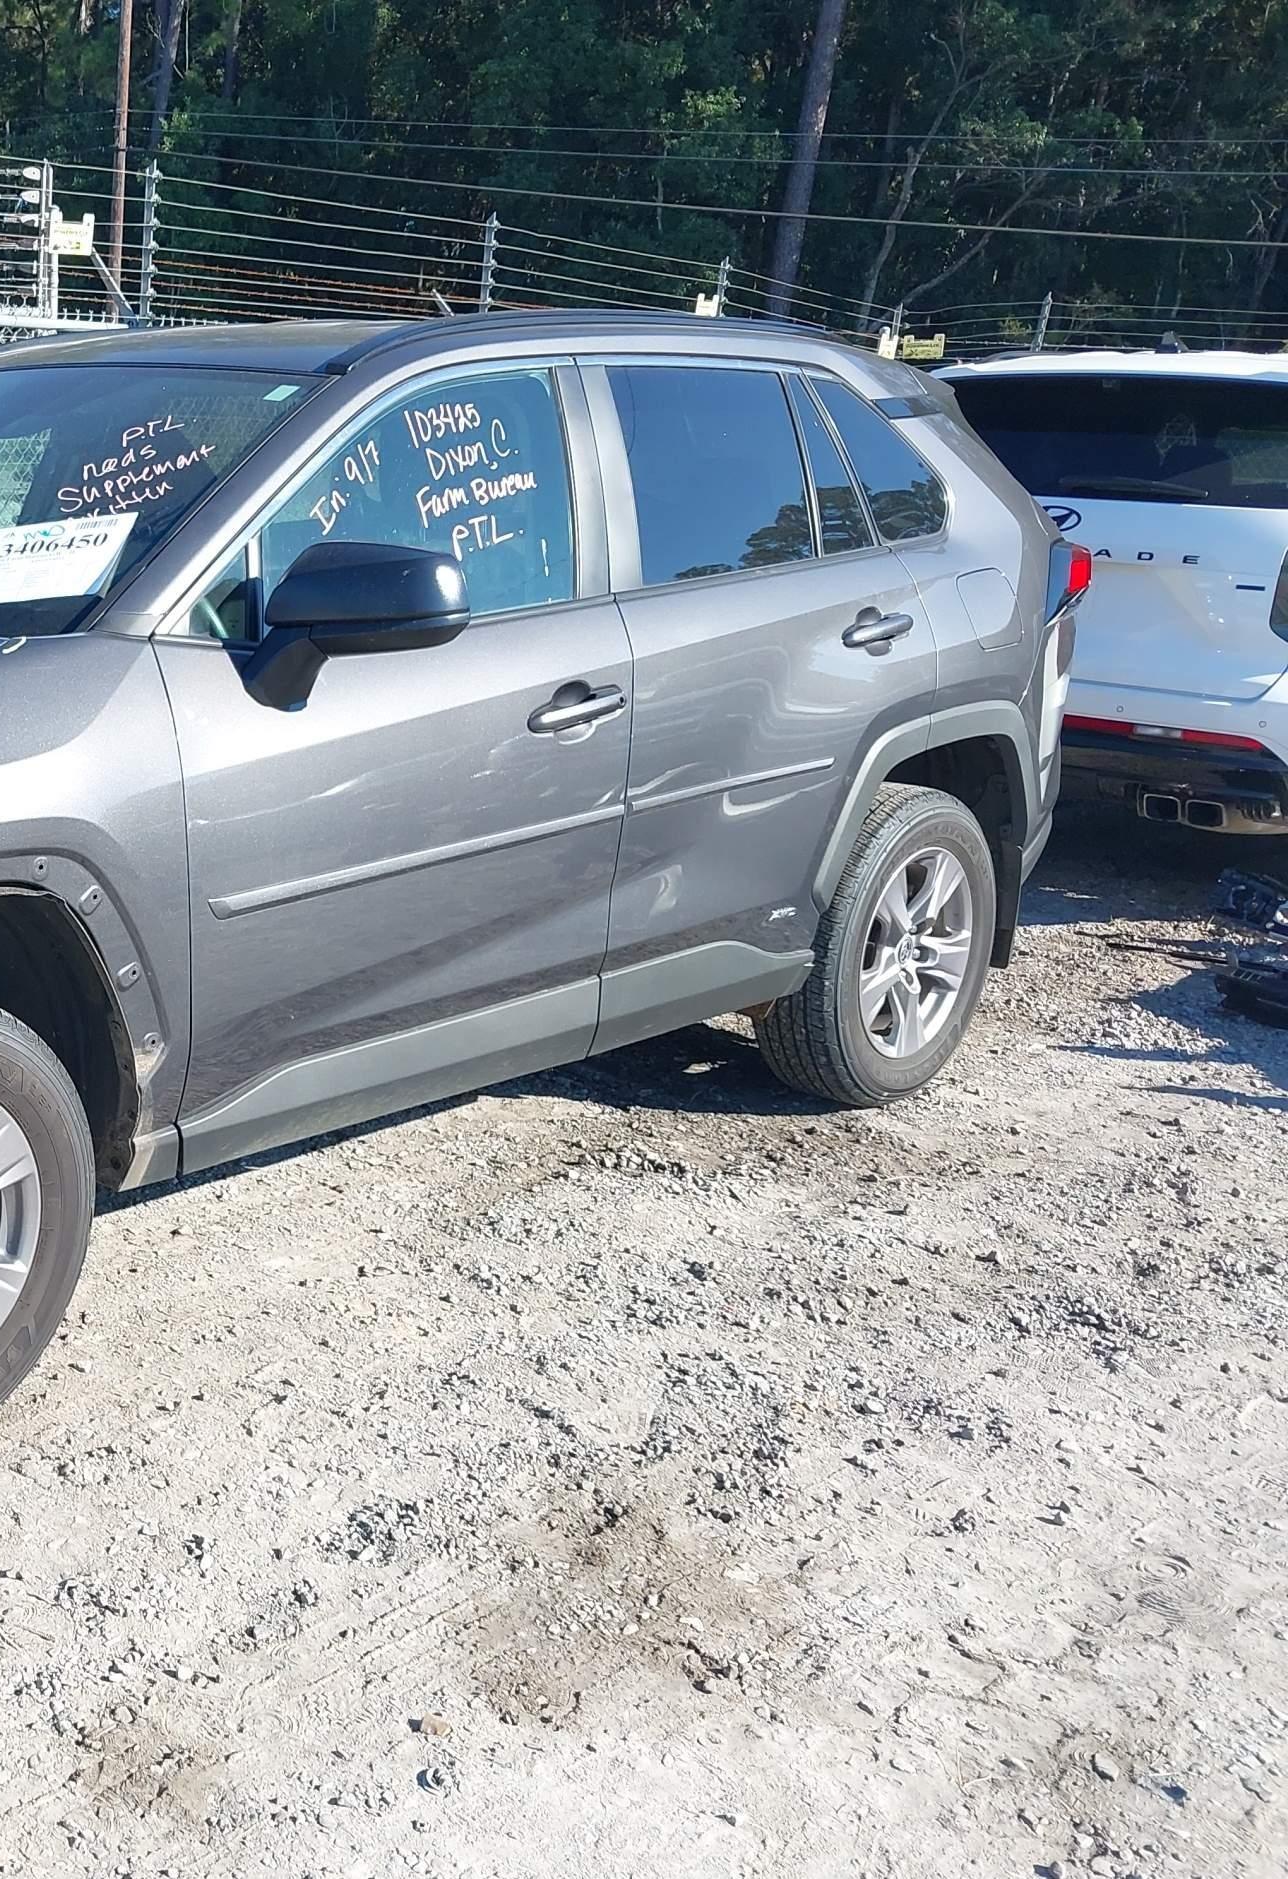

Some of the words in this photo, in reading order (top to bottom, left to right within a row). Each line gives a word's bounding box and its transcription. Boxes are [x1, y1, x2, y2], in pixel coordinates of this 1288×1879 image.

[403, 403, 481, 448] 103425
[491, 419, 520, 456] C.
[344, 439, 382, 485] 9/7
[68, 481, 174, 522] ritten
[416, 485, 468, 528] Farm
